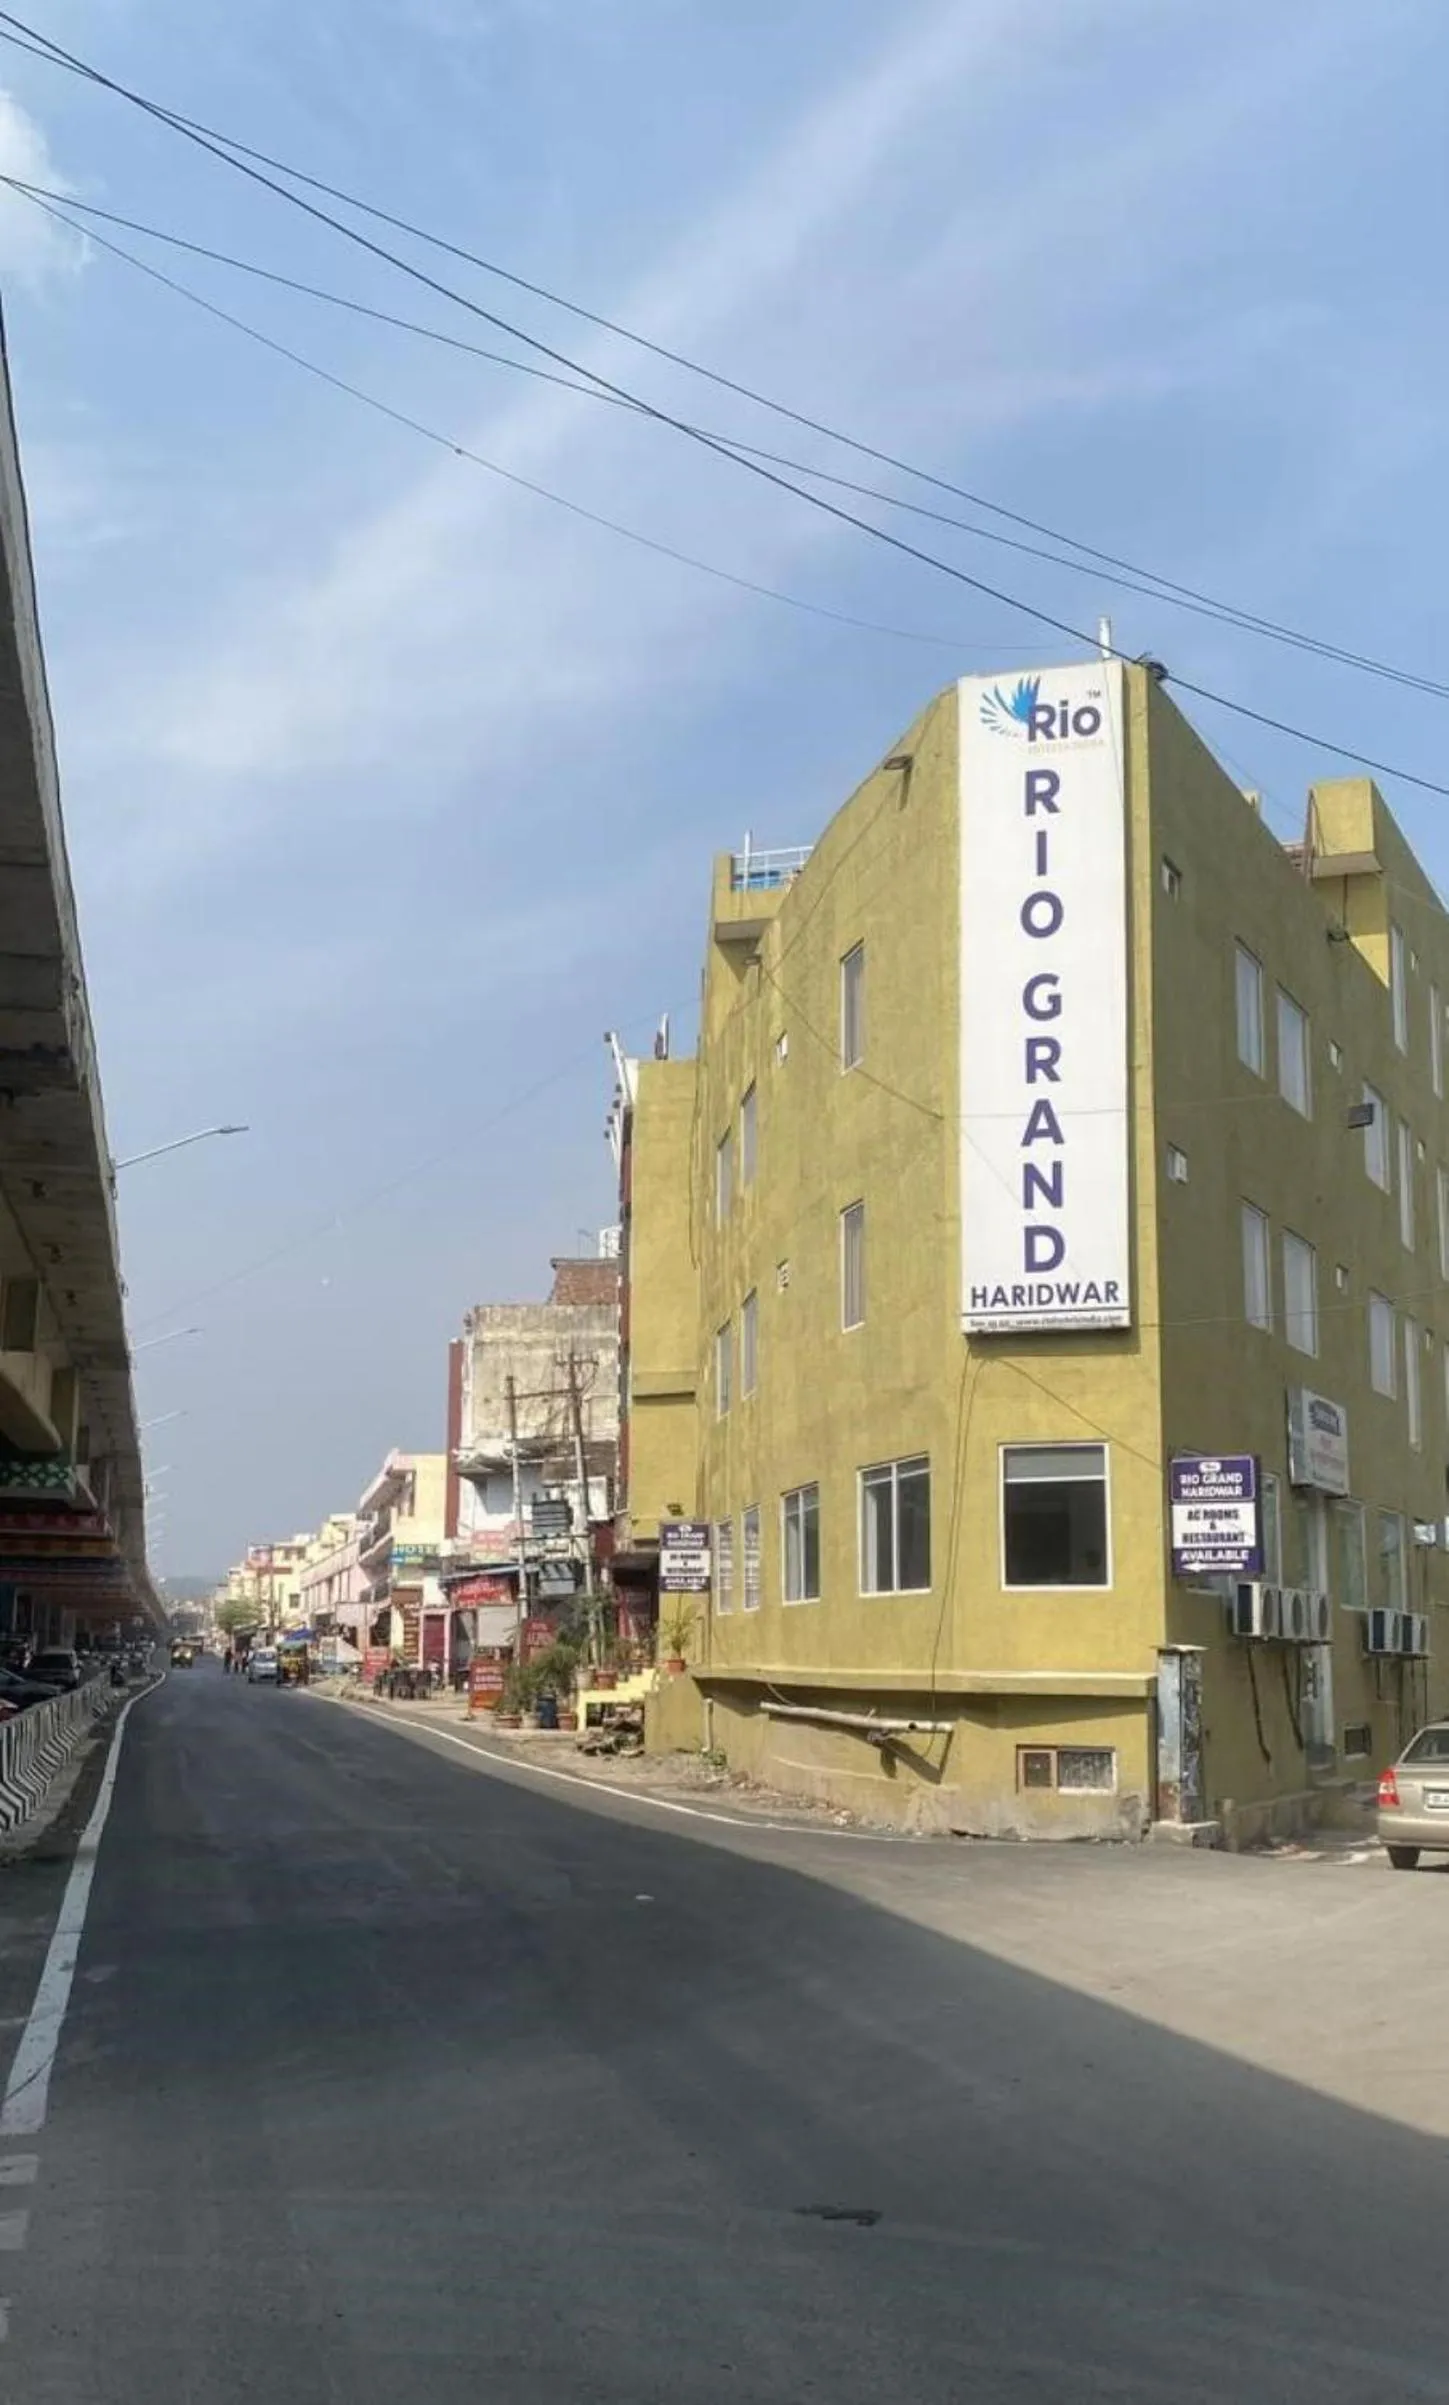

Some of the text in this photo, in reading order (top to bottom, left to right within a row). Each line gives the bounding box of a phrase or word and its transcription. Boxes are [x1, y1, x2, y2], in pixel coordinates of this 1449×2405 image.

[1028, 700, 1101, 742] Rio
[1020, 769, 1066, 1274] RIO GRAND
[970, 1281, 1120, 1308] HARIDWAR
[1179, 1472, 1244, 1485] RIO GRAND
[1180, 1486, 1243, 1497] HARIDWAR
[1187, 1509, 1239, 1521] AC ROOMS
[1181, 1549, 1250, 1561] AVAILABLE
